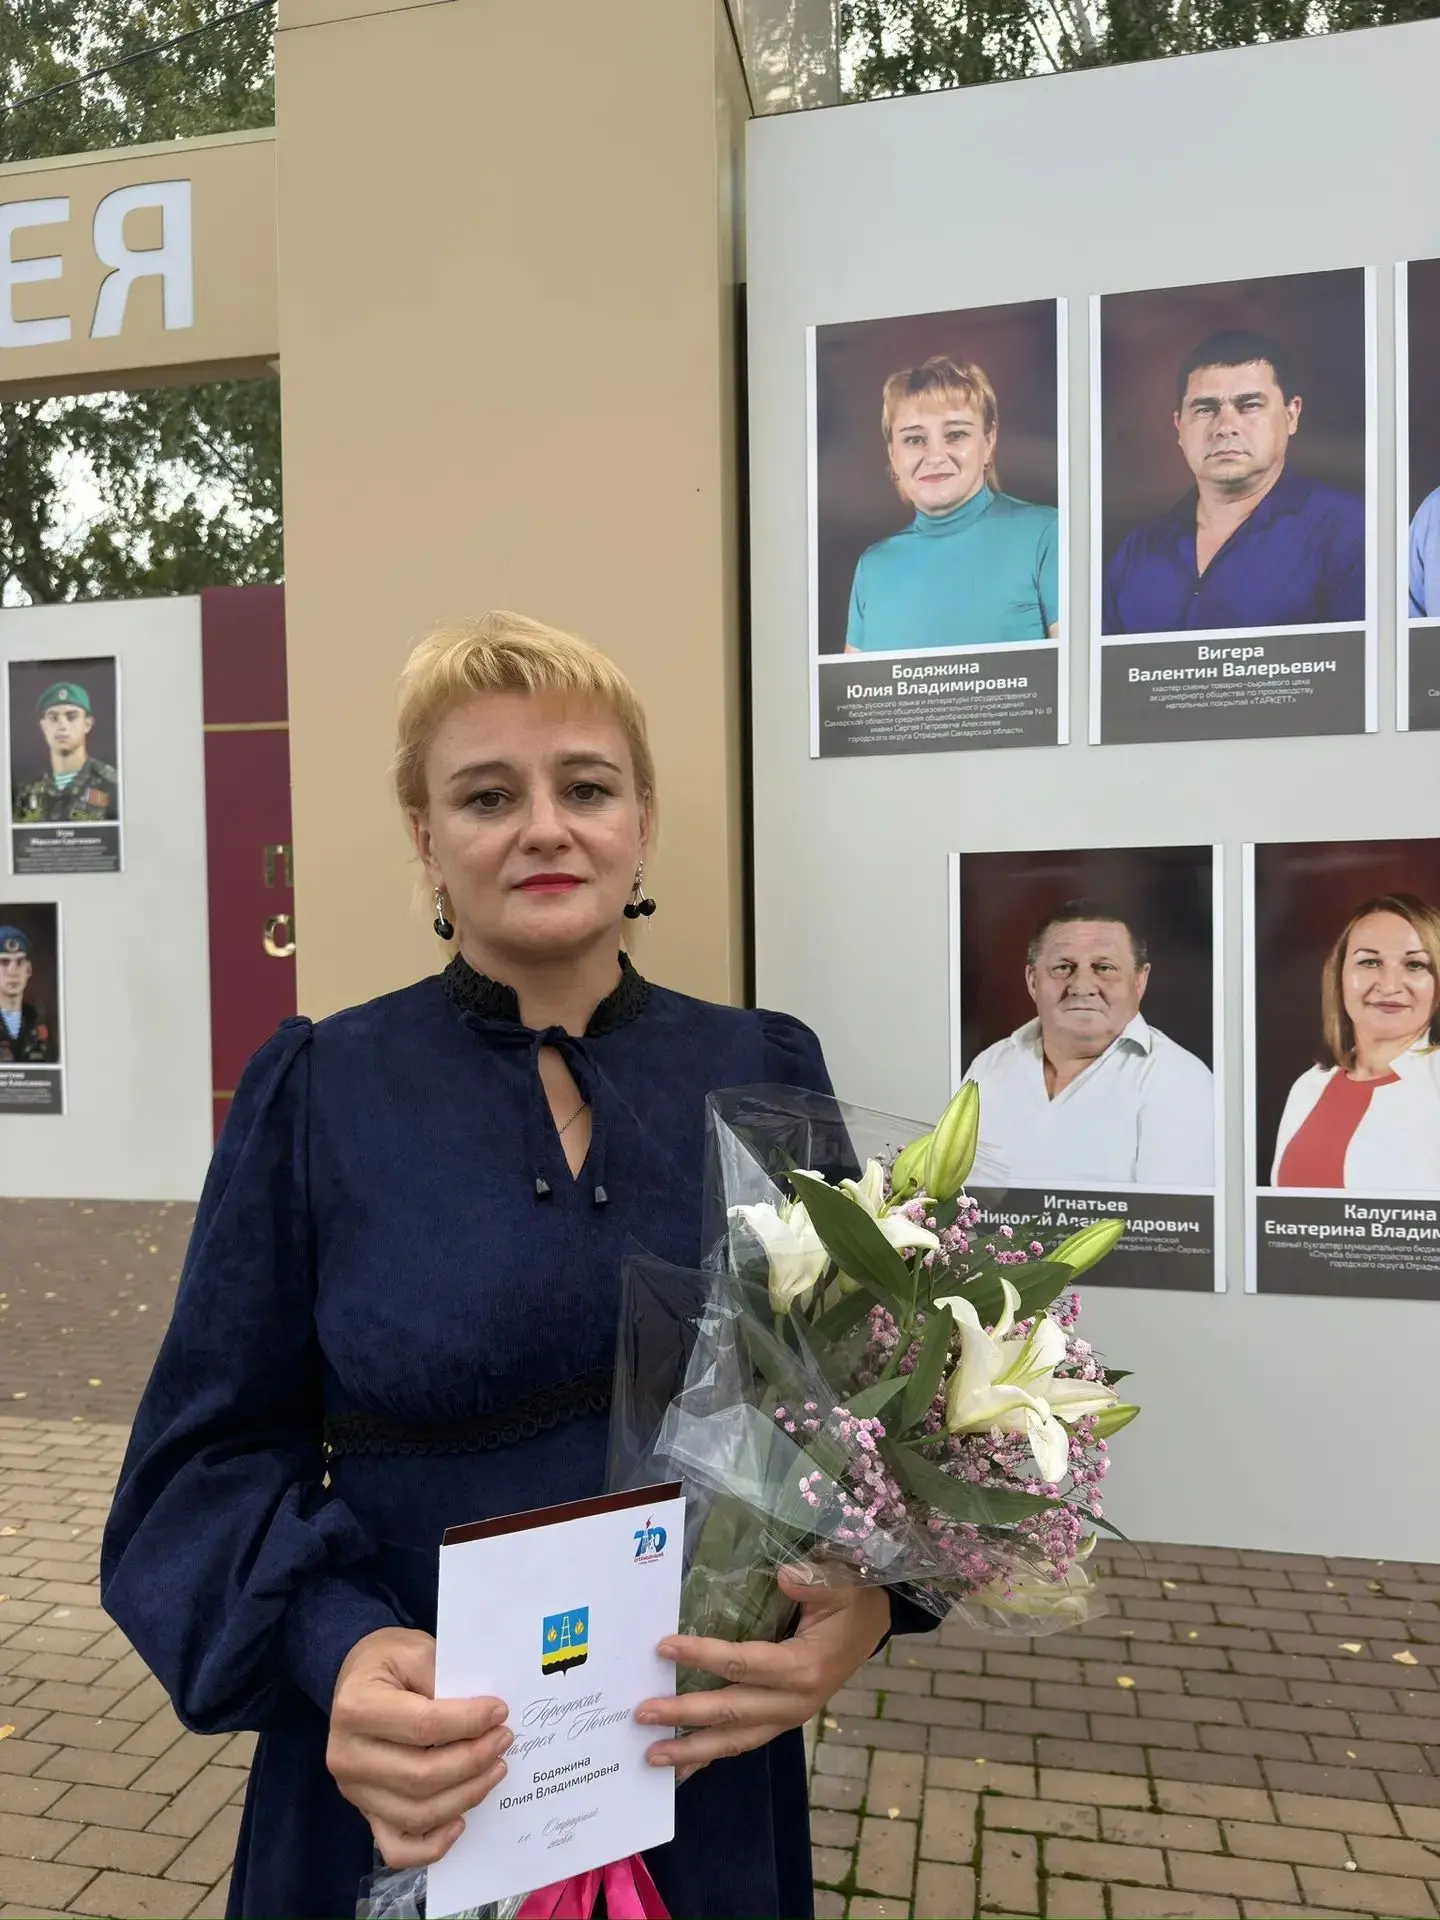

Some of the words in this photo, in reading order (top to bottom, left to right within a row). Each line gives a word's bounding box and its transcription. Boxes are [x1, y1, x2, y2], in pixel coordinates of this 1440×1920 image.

[1197, 645, 1264, 661] Вигера
[892, 661, 980, 682] Бодяжина
[1128, 666, 1218, 683] Валентин
[1223, 658, 1337, 680] Валерьевич
[847, 683, 893, 700] Юлия
[897, 675, 1028, 697] Владимировна
[1152, 685, 1181, 693] мастер
[1206, 690, 1246, 699] общества
[865, 701, 897, 710] русского
[848, 734, 888, 743] городского
[1043, 1195, 1128, 1212] Игнатьев
[1344, 1204, 1437, 1223] Калугина
[1265, 1220, 1366, 1239] Екатерина
[1329, 1261, 1375, 1269] городского
[521, 1690, 603, 1729] Городская
[532, 1755, 592, 1785] Бодяжина
[499, 1791, 534, 1810] Юлия
[536, 1761, 620, 1801] Владимировна
